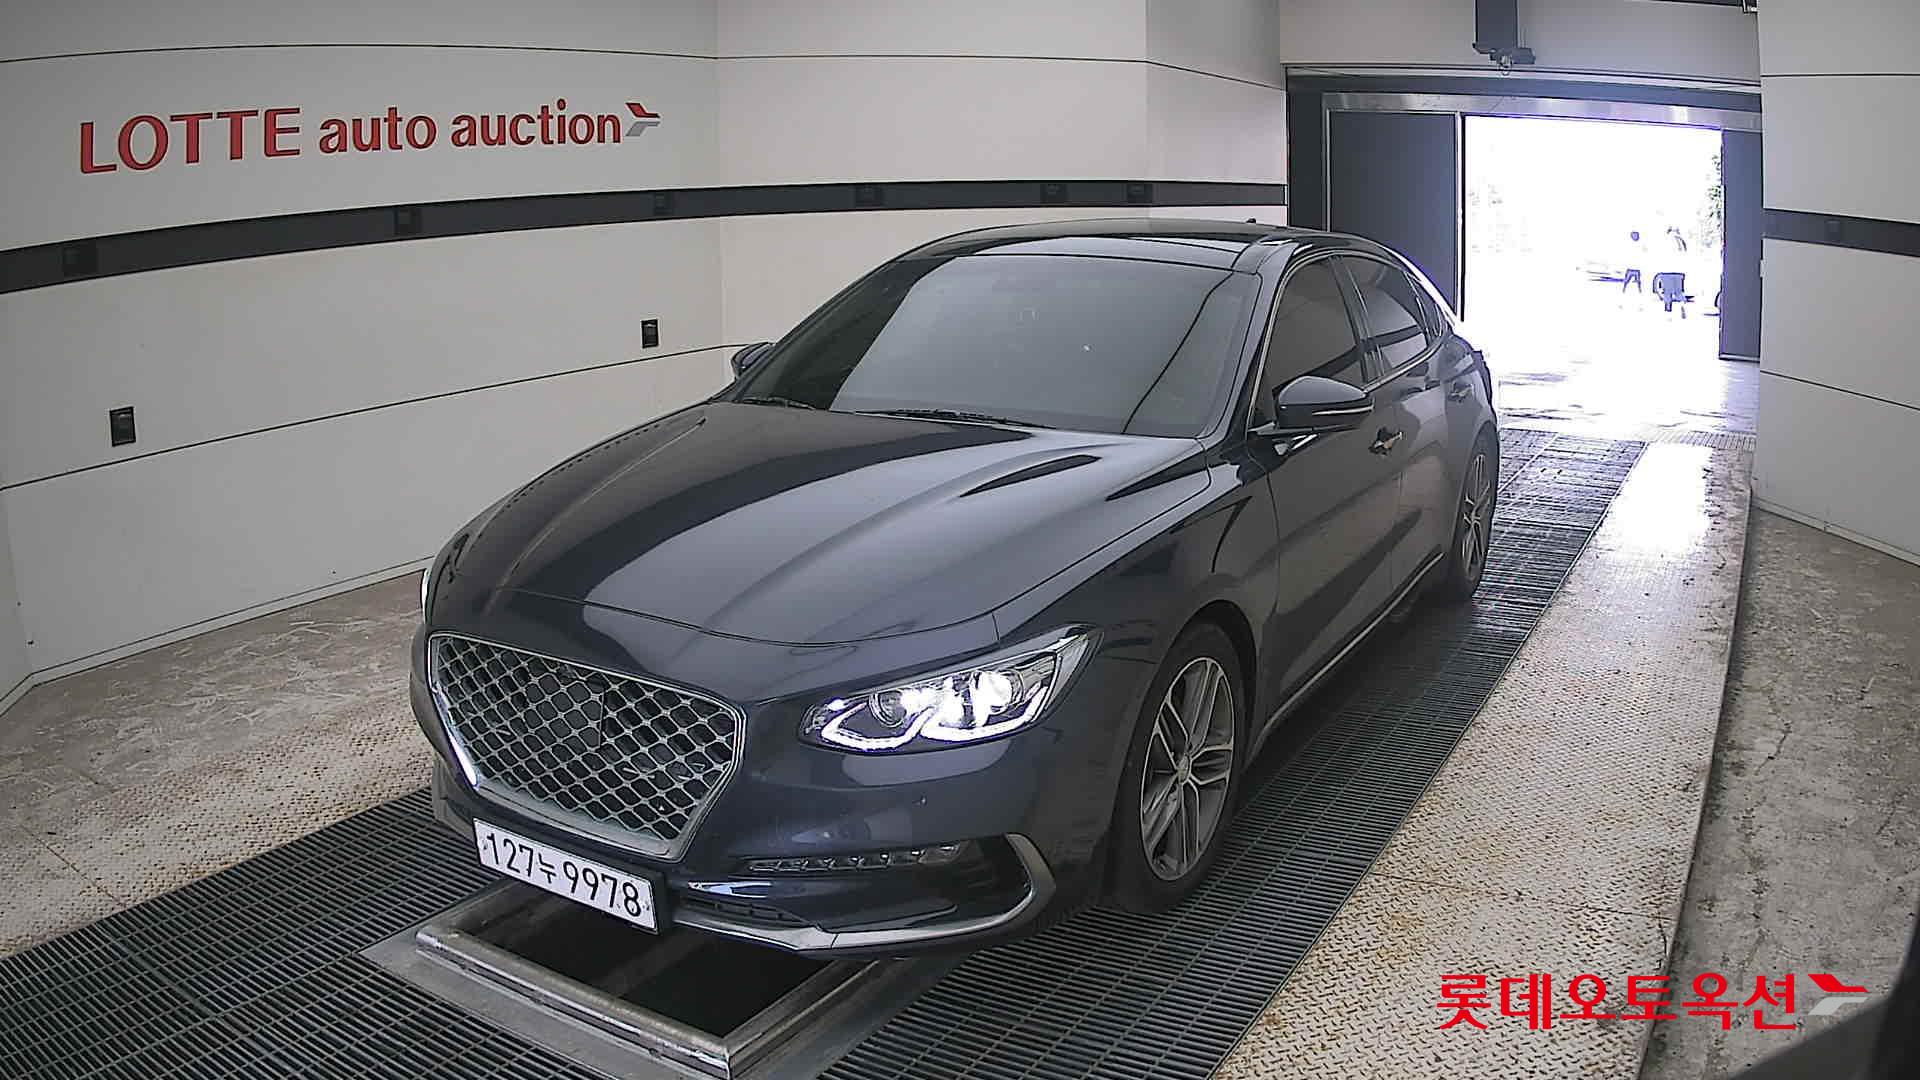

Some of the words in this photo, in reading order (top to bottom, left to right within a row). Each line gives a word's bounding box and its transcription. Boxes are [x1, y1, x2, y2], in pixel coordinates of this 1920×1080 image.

[80, 107, 302, 174] LOTTE
[320, 107, 437, 154] auto
[450, 98, 622, 147] auction
